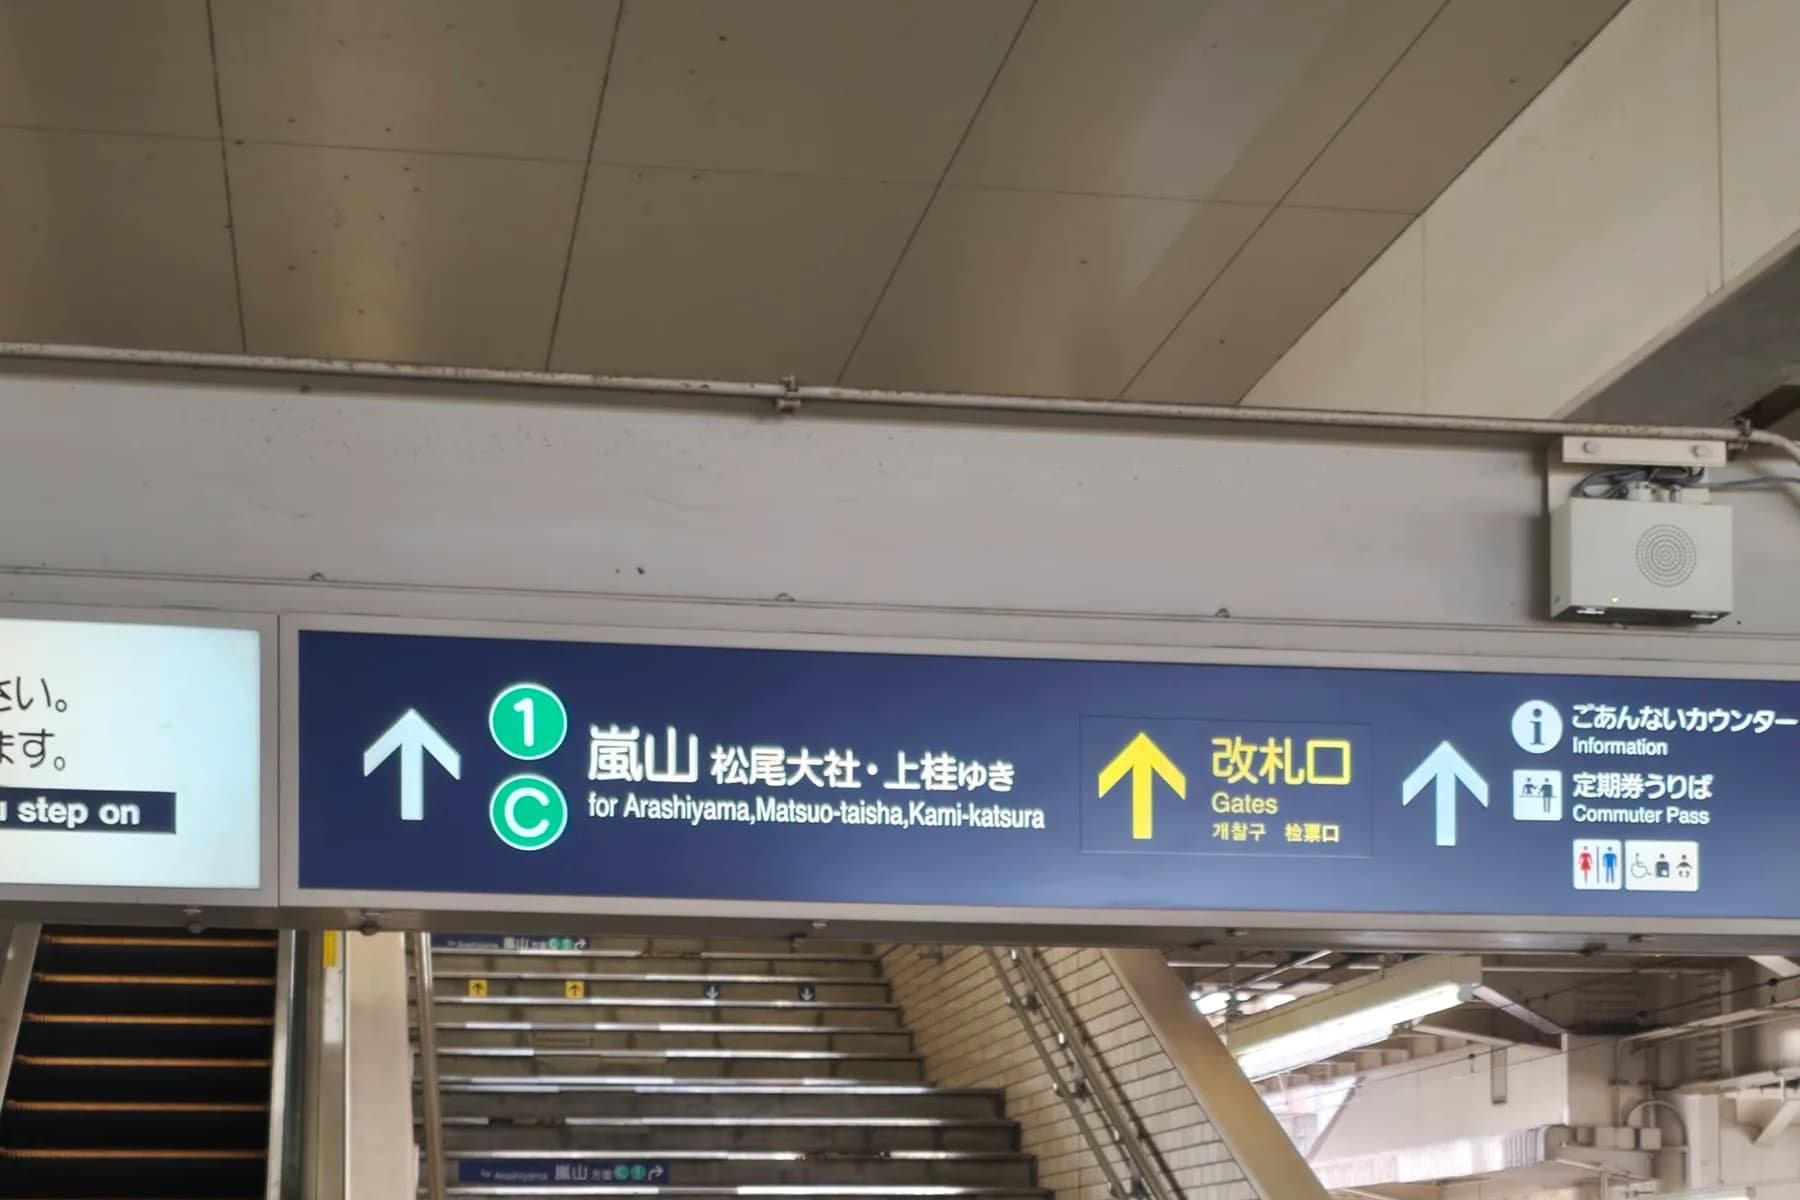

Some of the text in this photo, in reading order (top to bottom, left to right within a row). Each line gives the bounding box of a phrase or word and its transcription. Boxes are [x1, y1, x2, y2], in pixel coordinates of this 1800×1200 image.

[512, 697, 536, 748] 1
[1572, 704, 1798, 733] ごあんないカウンター
[588, 724, 1015, 792] 嵐山 松尾大社・上桂ゆき
[1212, 736, 1351, 785] 改札口
[1572, 736, 1668, 756] Information
[1572, 772, 1714, 800] 定期券うりば
[17, 796, 89, 829] step
[98, 803, 140, 825] on
[503, 786, 551, 839] C
[588, 792, 618, 817] for
[1211, 791, 1279, 815] Gates
[1572, 804, 1710, 825] Commuter Pass
